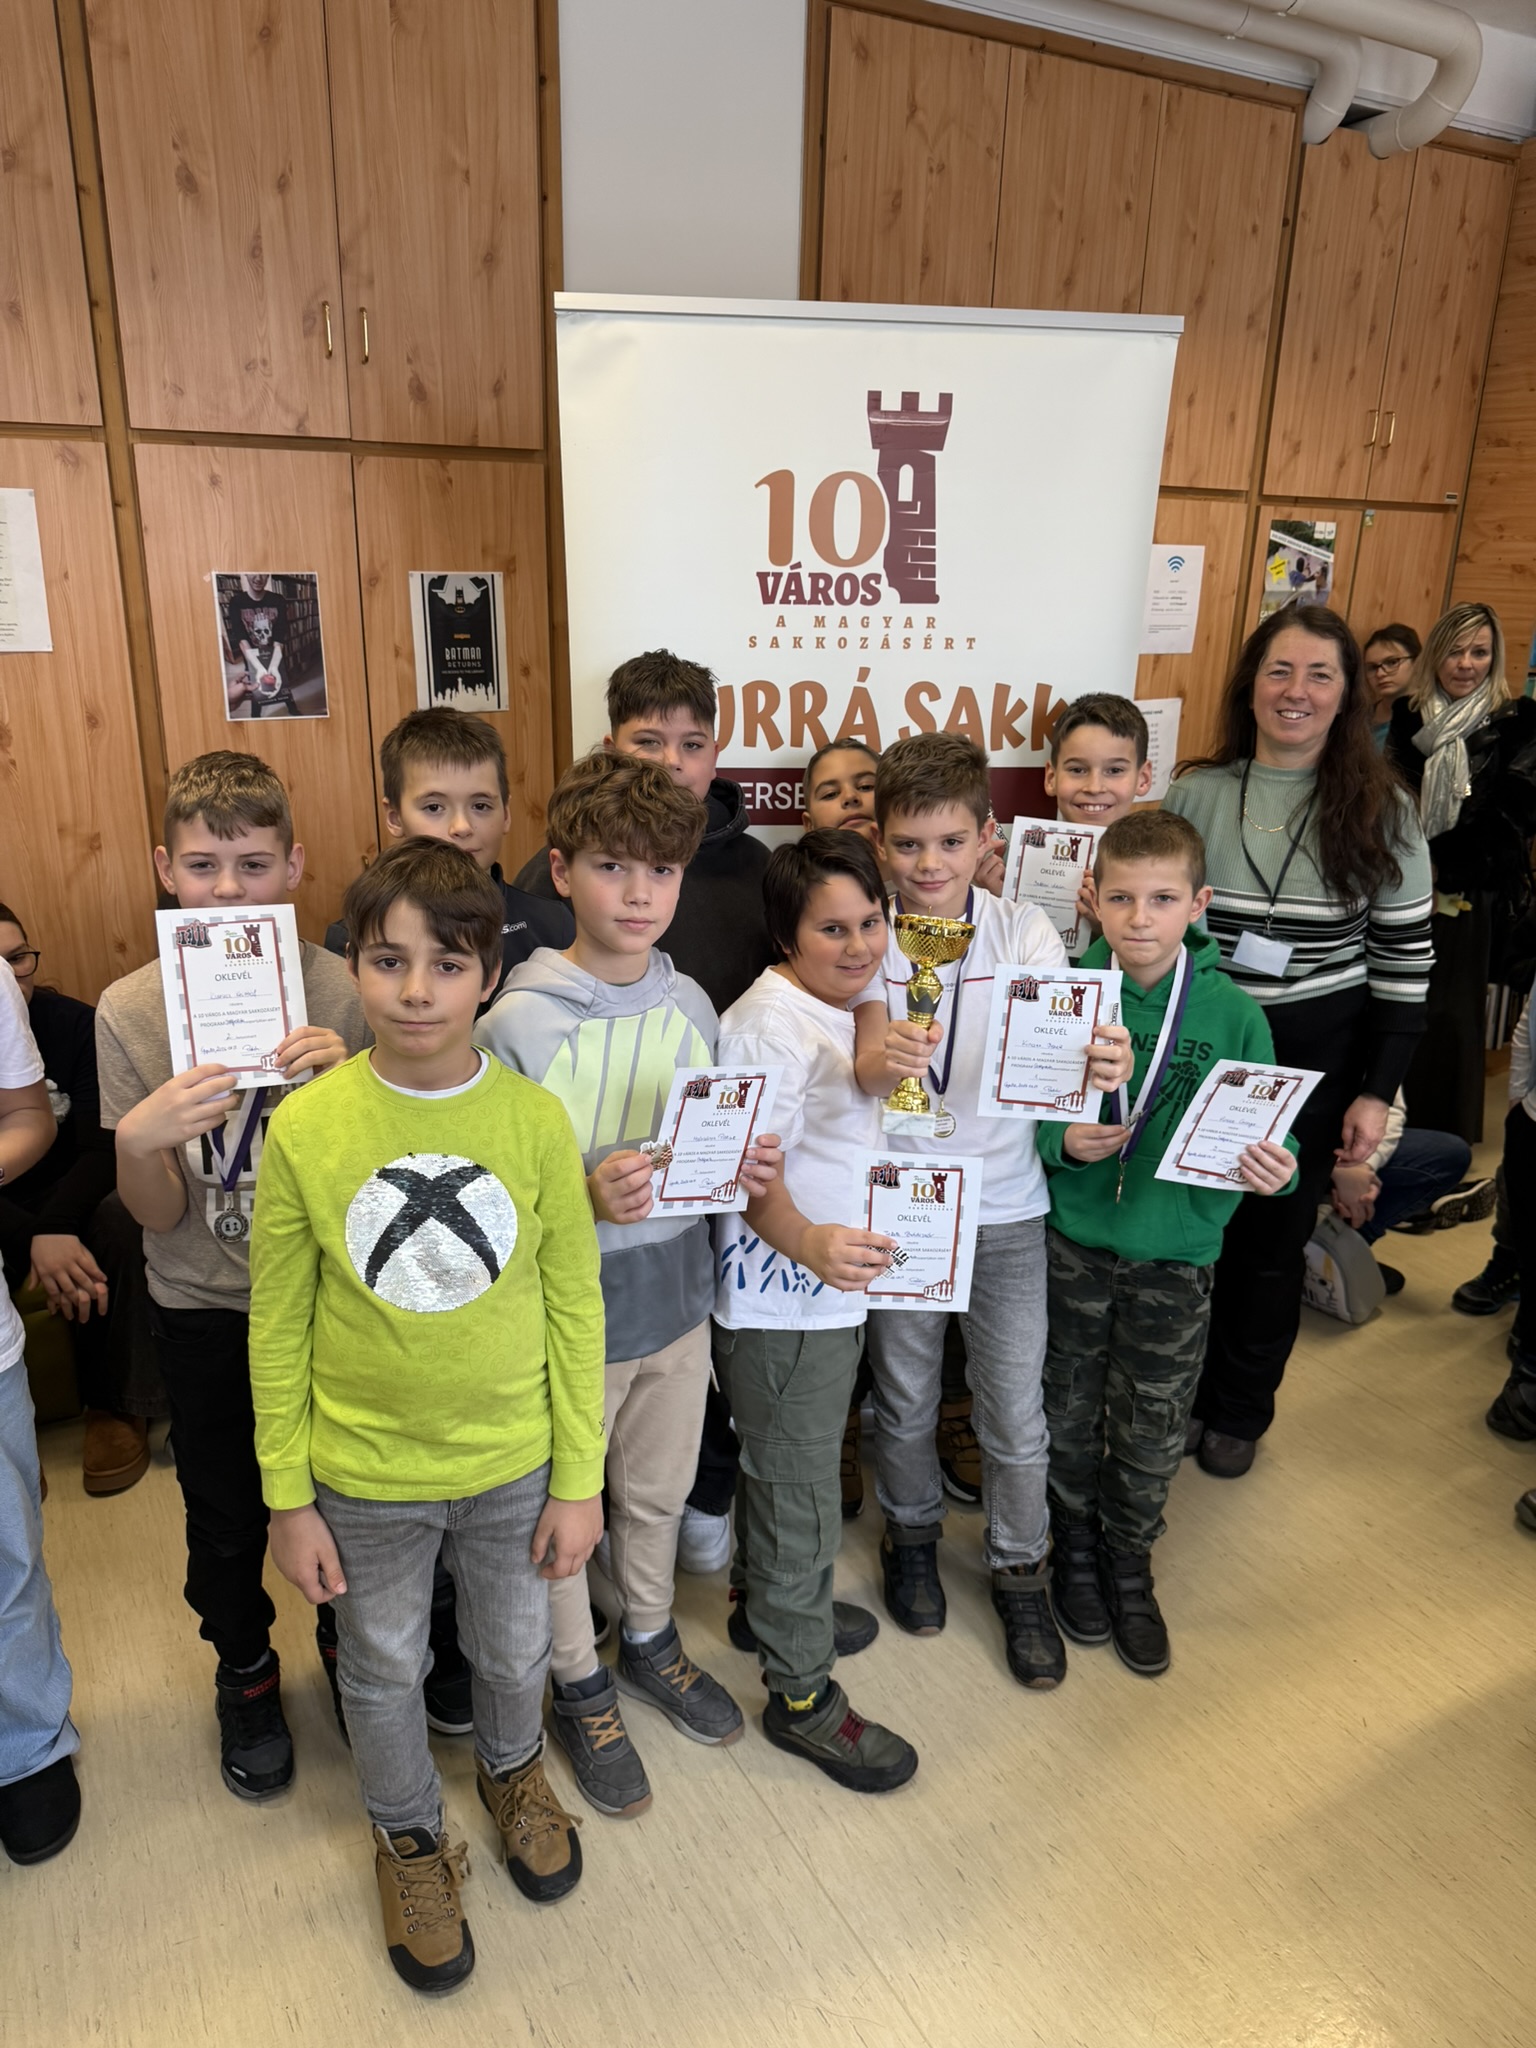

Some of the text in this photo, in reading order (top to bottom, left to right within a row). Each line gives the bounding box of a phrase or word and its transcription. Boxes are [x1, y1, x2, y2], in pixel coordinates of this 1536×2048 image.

[754, 468, 886, 568] 10
[756, 561, 882, 606] VÁROS
[775, 615, 937, 629] A MAGYAR
[748, 634, 976, 650] SAKKOZÁSÉRT
[445, 647, 482, 660] BATMAN
[716, 667, 881, 752] URRÁ
[738, 782, 807, 810] ERSE
[223, 937, 251, 953] 10
[225, 952, 252, 960] VÁROS
[215, 971, 252, 982] OKLEVÉL
[1050, 995, 1074, 1011] 10
[1034, 1026, 1068, 1036] OKLEVÉL
[719, 1091, 739, 1104] 10
[701, 1119, 730, 1128] OKLEVÉL
[911, 1183, 936, 1198] 10
[897, 1214, 932, 1223] OKLEVÉL
